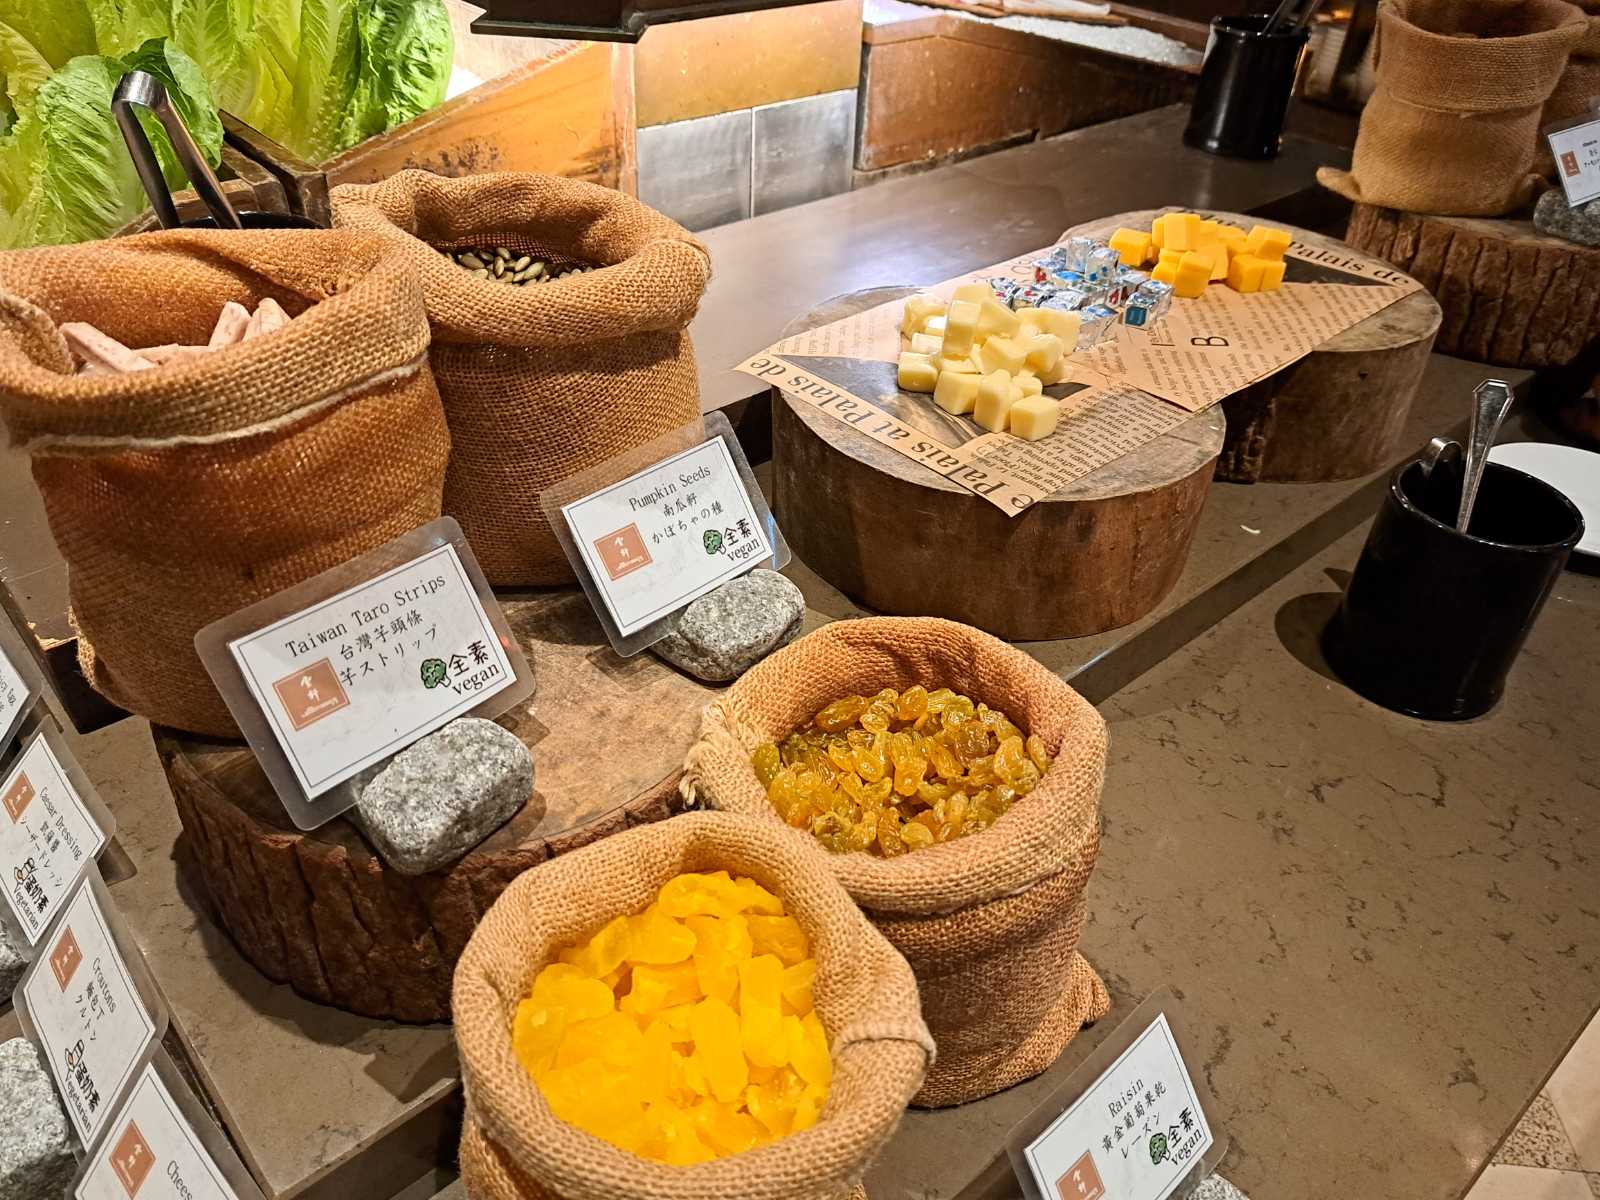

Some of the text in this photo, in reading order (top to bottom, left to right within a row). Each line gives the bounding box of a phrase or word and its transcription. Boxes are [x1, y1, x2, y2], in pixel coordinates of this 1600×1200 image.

[750, 357, 786, 377] de
[787, 374, 873, 426] Palais
[872, 421, 915, 442] at
[629, 466, 711, 512] Pumpkin Seeds
[911, 440, 1007, 497] Palais
[652, 502, 724, 544] かぼちゃの種
[663, 493, 698, 517] 南瓜籽
[723, 518, 752, 547] 全素
[727, 539, 760, 562] vegan
[285, 574, 446, 658] Taiwan Taro Strips
[340, 609, 424, 661] 台灣芋頭條
[340, 624, 438, 688] 芋ストリップ
[449, 640, 489, 677] 全素
[452, 663, 501, 696] vegan
[56, 815, 82, 861] Dressing
[14, 880, 39, 930] Vegetarian
[24, 873, 49, 914] 蛋奶素
[92, 957, 117, 1014] Croutons
[65, 1071, 92, 1134] Vegetarian
[75, 1064, 101, 1113] 蛋奶素
[1108, 1078, 1144, 1118] Raisin
[1121, 1112, 1160, 1160] レーズン
[1168, 1107, 1195, 1148] 全素
[1171, 1129, 1202, 1166] vegan
